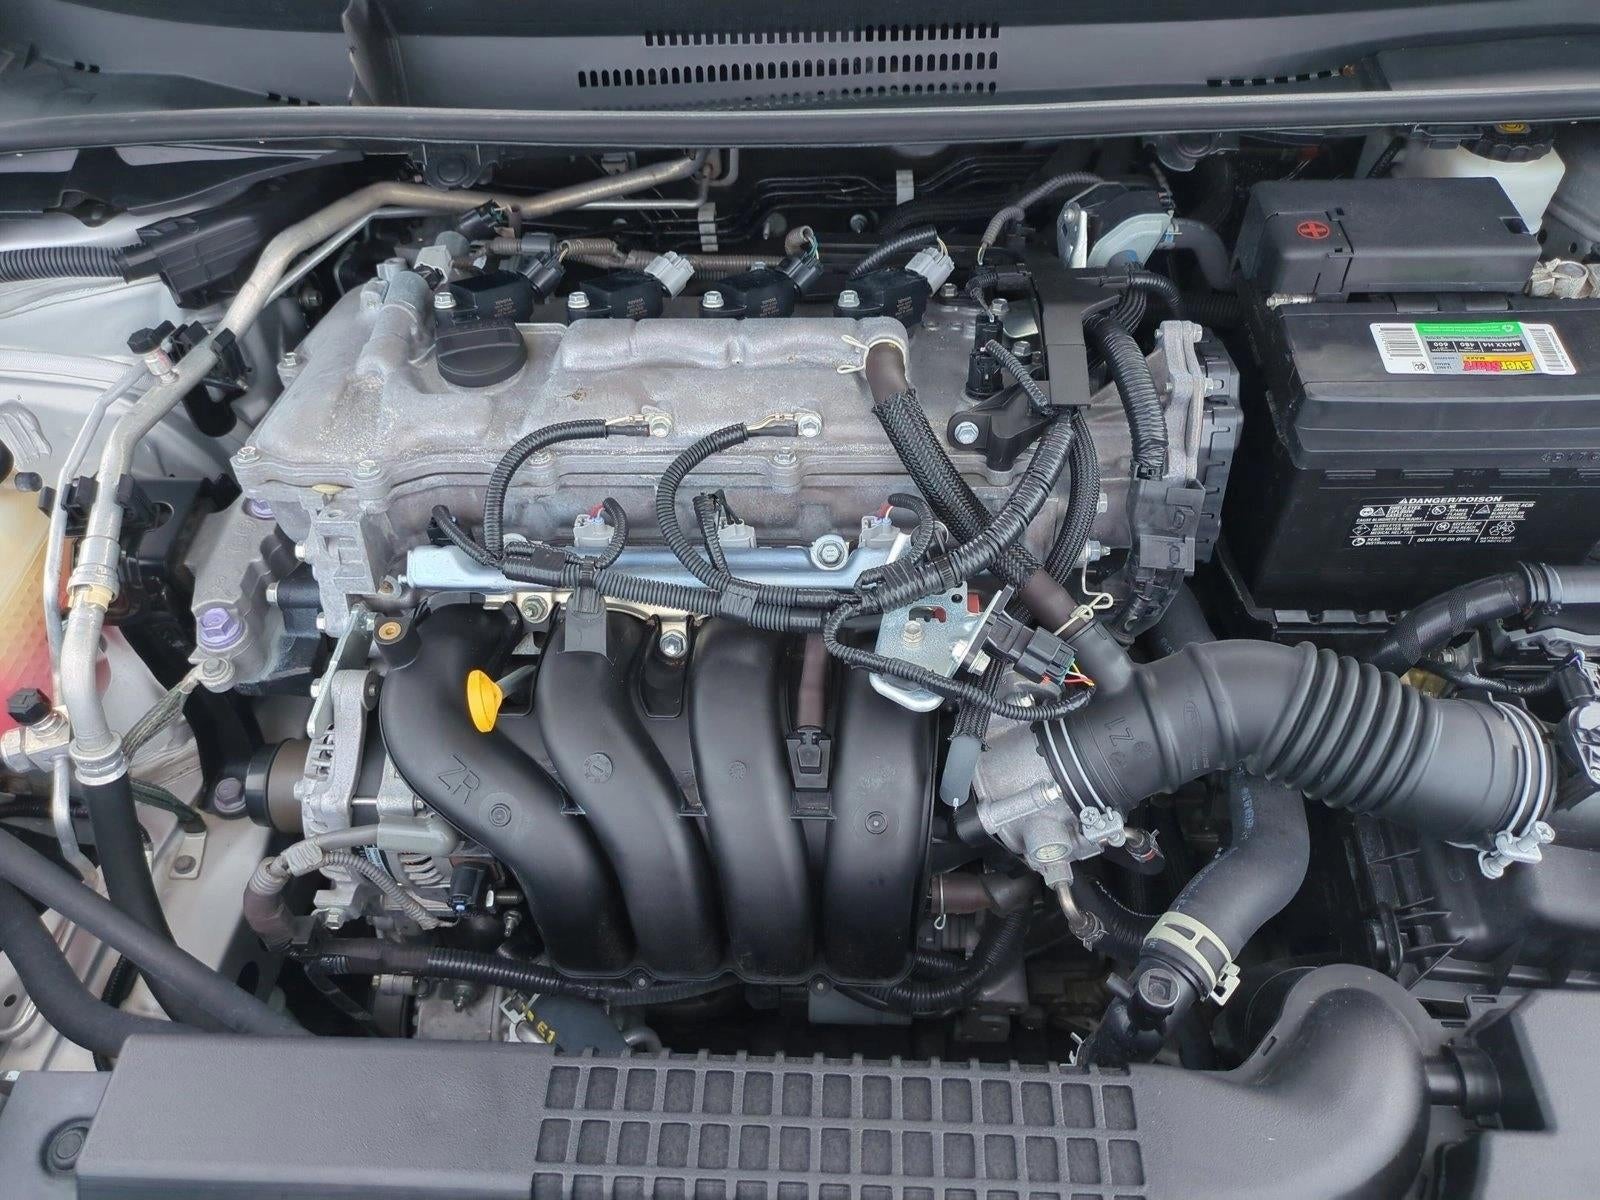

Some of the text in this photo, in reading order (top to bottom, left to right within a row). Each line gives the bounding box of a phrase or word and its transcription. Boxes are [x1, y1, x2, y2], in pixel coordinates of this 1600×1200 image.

[1463, 360, 1535, 371] EverStart
[1408, 496, 1502, 504] DANGER/POISON
[438, 755, 480, 804] ZR
